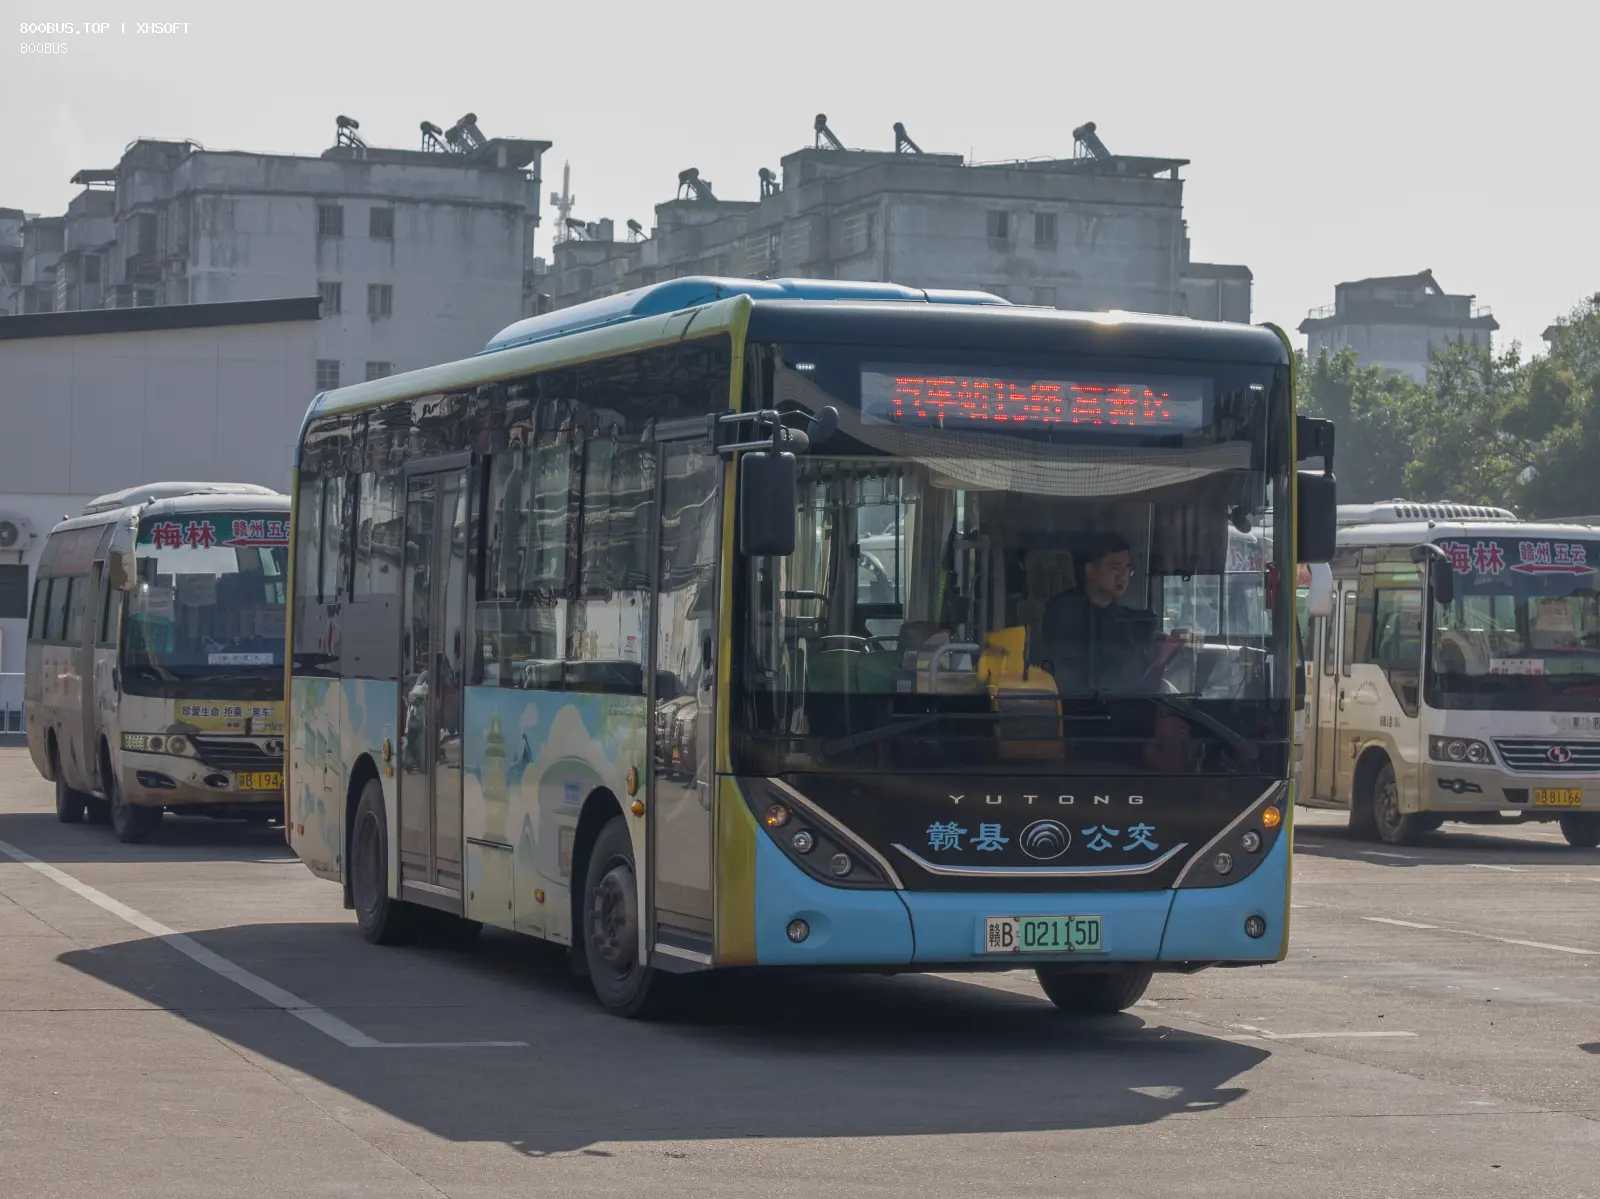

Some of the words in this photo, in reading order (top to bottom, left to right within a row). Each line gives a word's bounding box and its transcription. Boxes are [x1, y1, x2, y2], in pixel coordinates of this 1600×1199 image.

[152, 521, 217, 549] 梅林
[1441, 541, 1504, 574] 梅林
[1518, 541, 1587, 564] 赣州五云
[948, 794, 1144, 806] YUTONG
[925, 821, 1010, 852] 赣县
[1080, 822, 1160, 852] 公交
